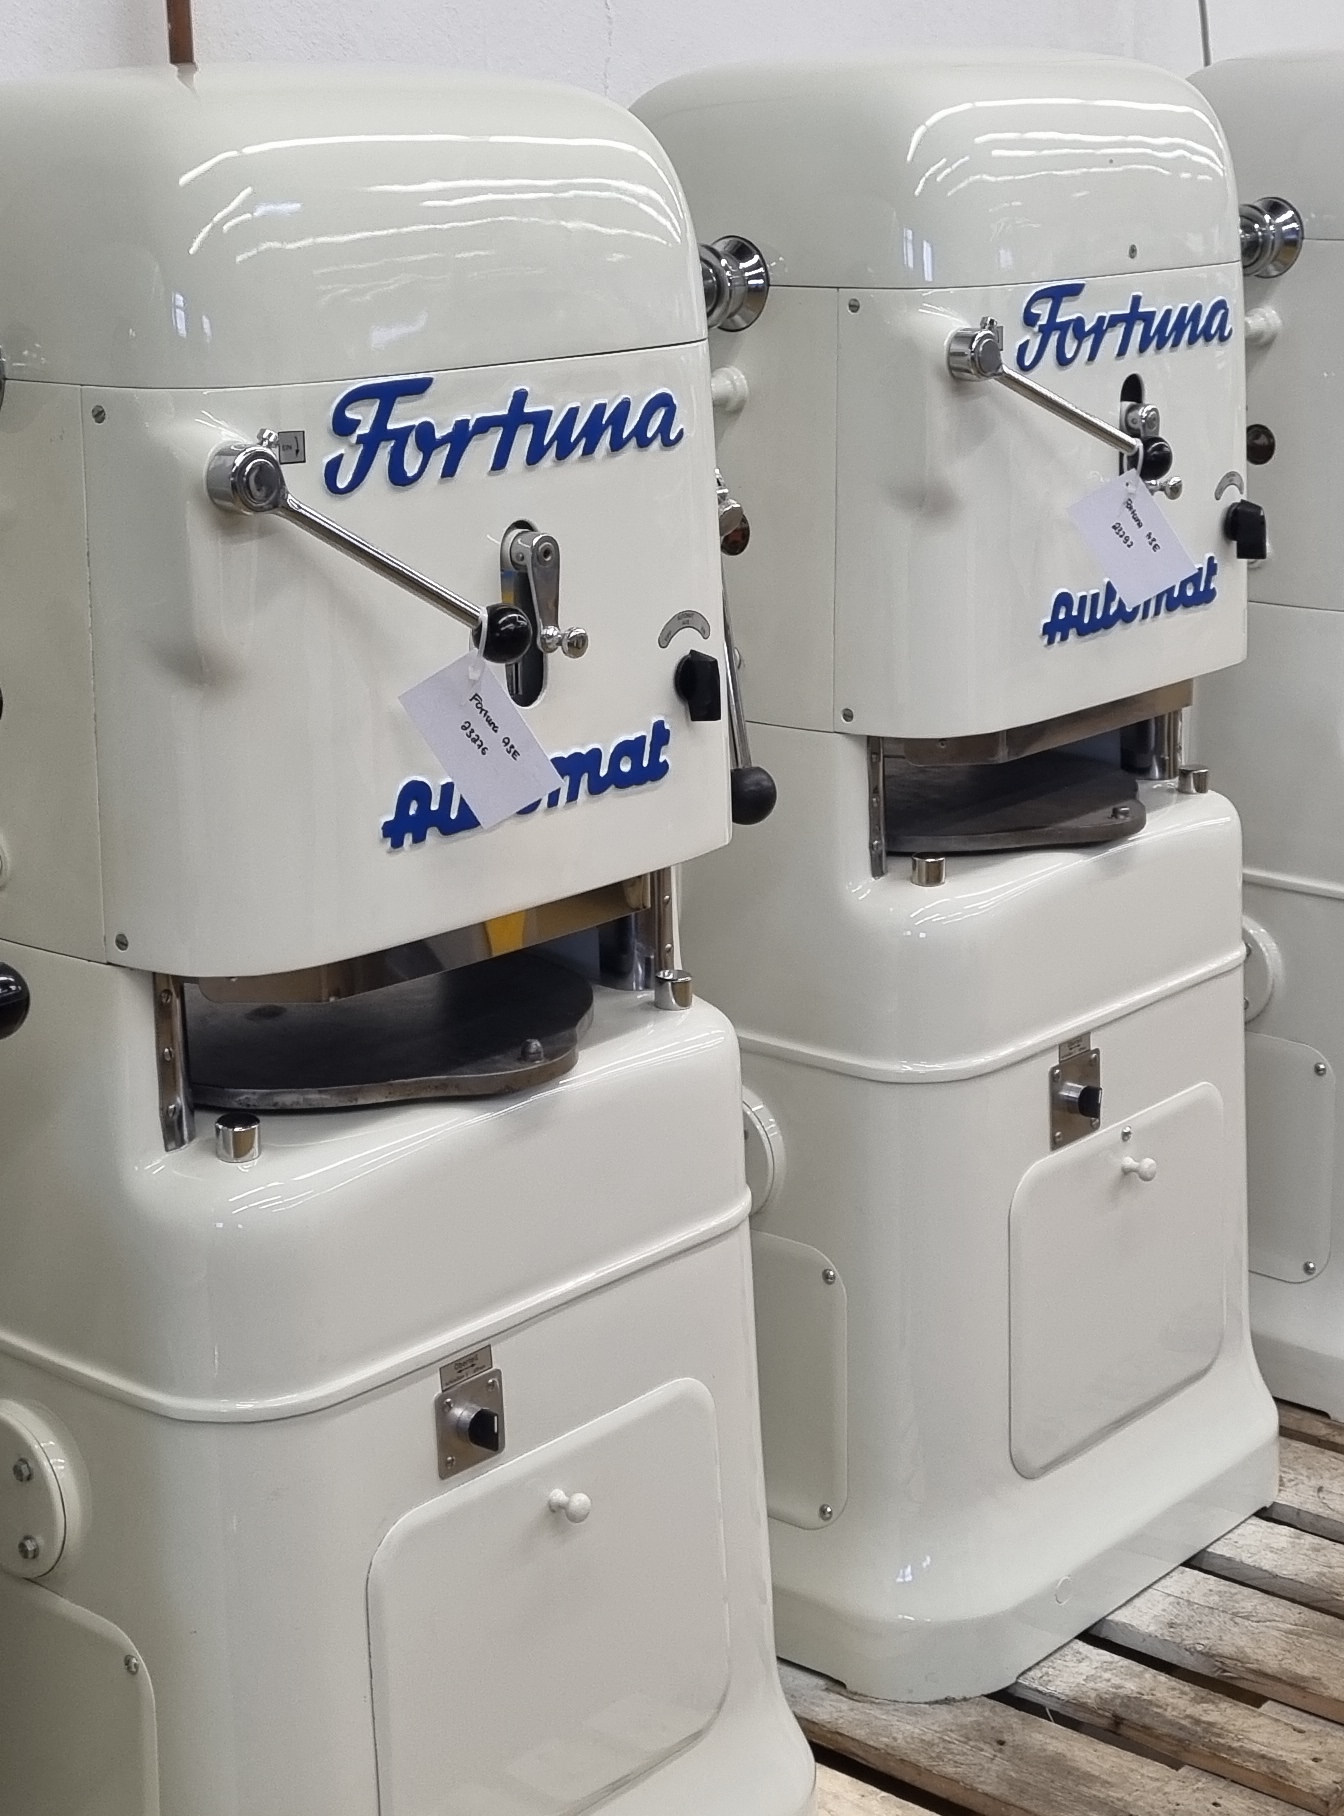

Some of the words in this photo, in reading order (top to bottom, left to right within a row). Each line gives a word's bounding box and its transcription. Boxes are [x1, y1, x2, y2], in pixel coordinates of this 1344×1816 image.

[1017, 283, 1232, 372] Fortuna
[324, 377, 684, 495] Fortuna
[468, 693, 499, 734] Fortuna
